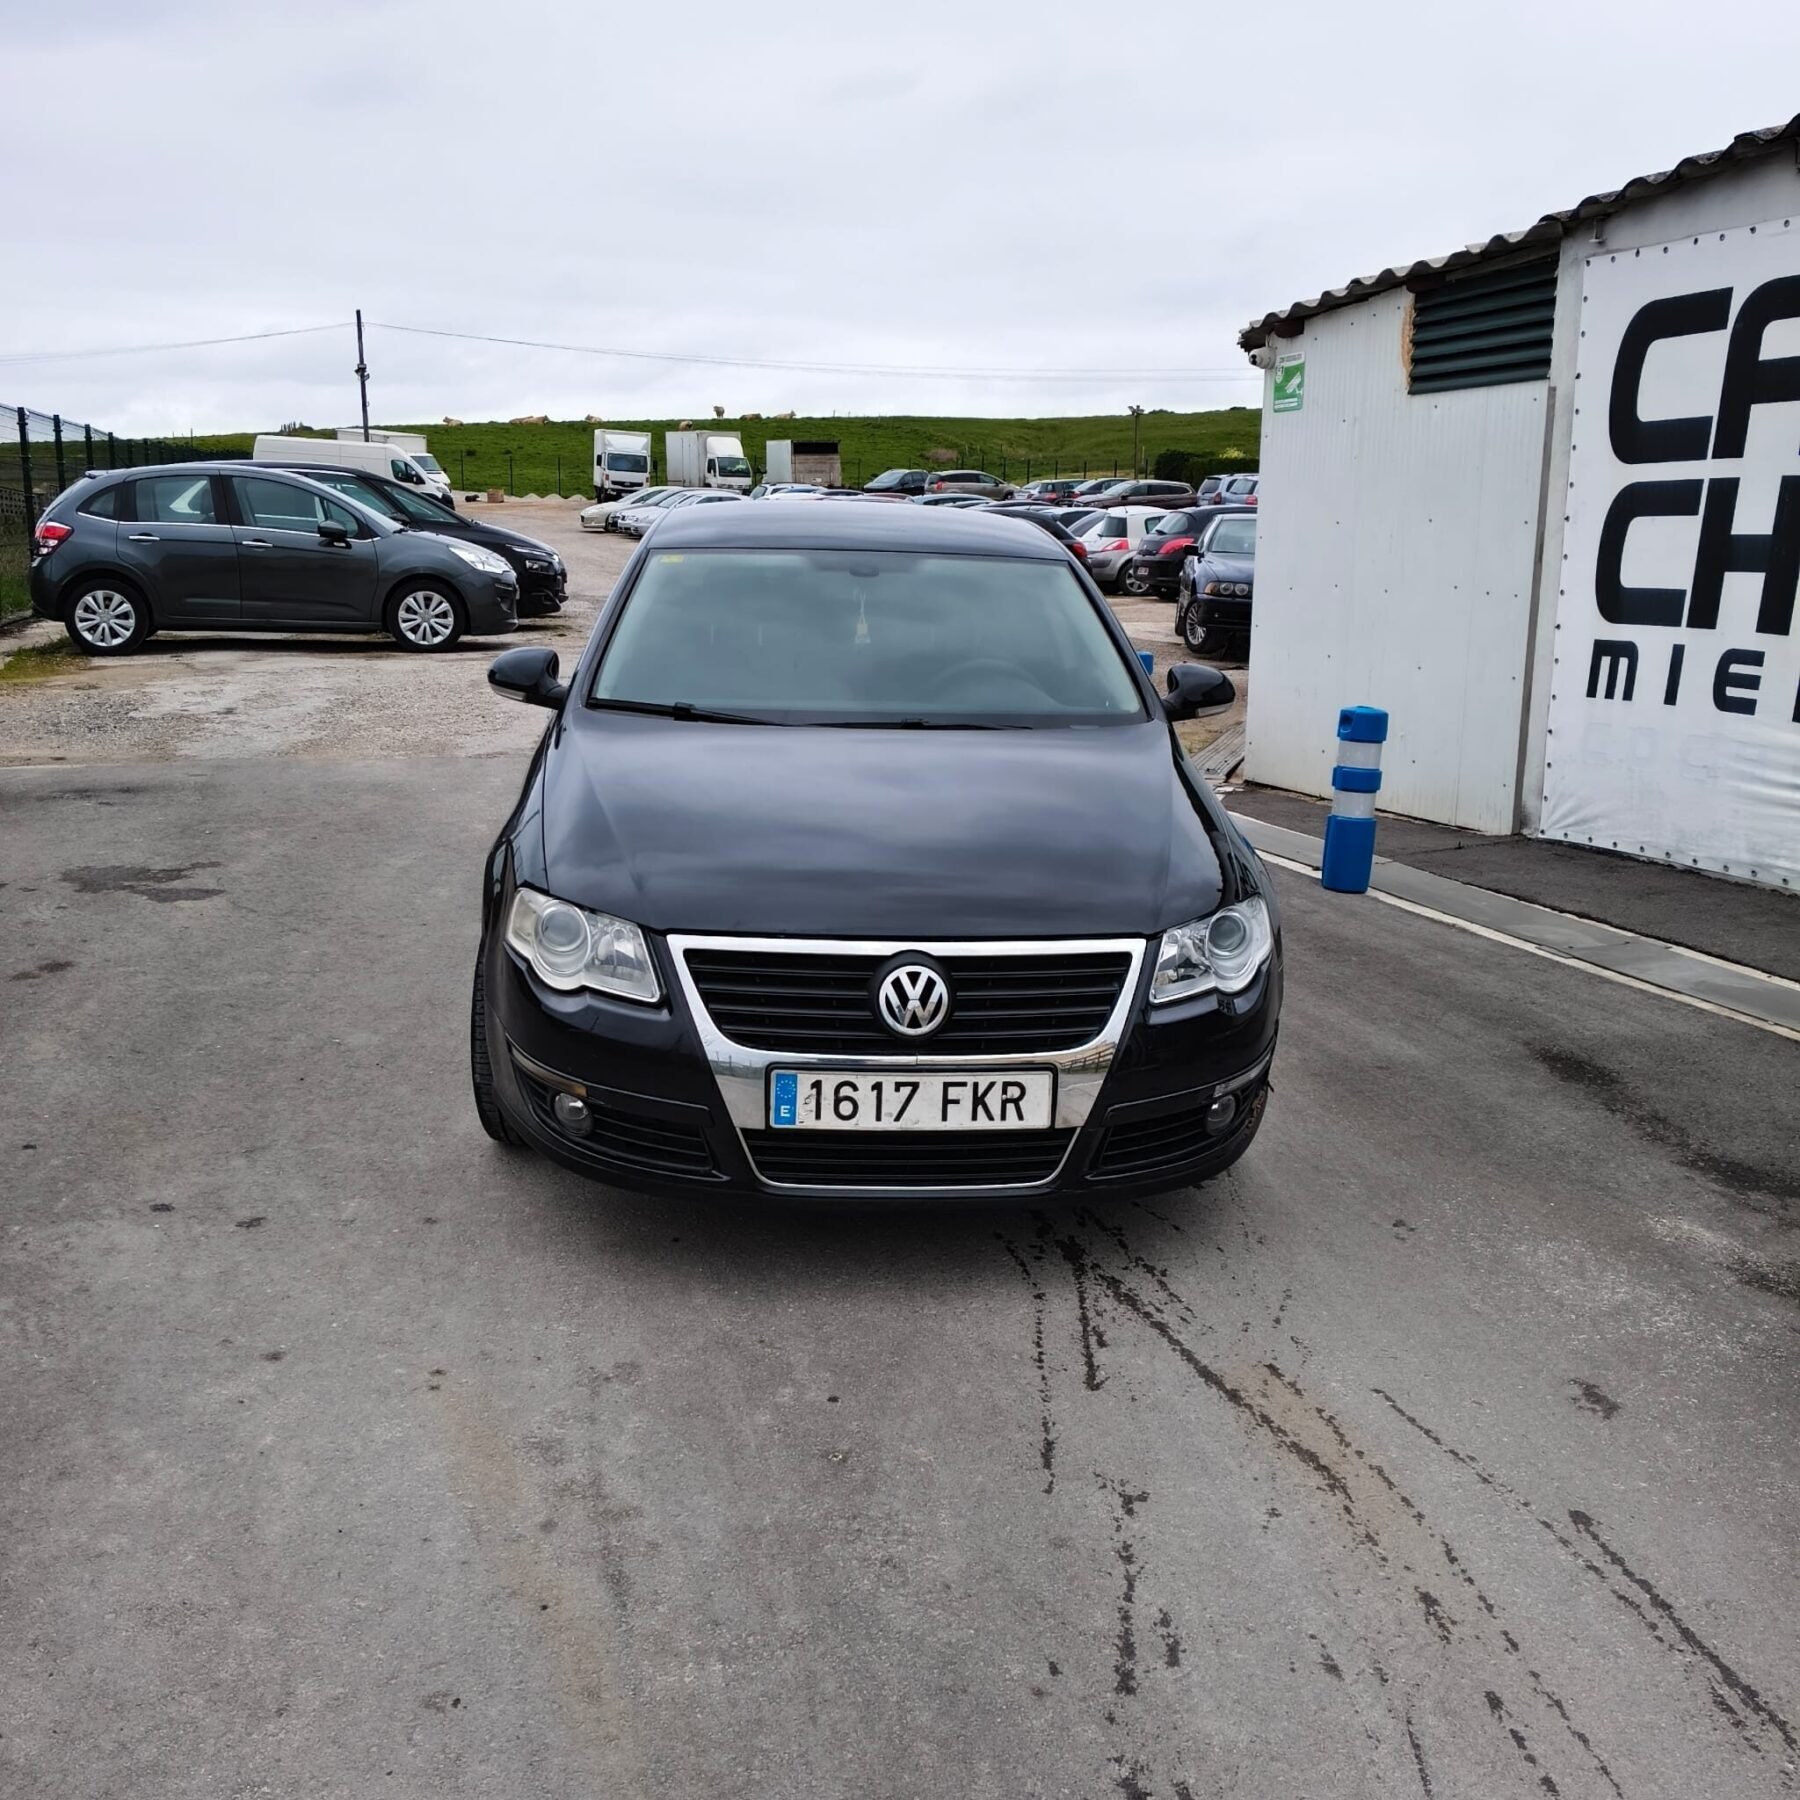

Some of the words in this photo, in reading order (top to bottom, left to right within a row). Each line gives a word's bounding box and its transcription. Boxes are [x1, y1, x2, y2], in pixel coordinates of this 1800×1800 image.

[1596, 475, 1800, 635] CH
[1586, 640, 1800, 723] MIE
[882, 967, 946, 1033] VW
[780, 1105, 791, 1117] E
[810, 1080, 920, 1122] 1617
[941, 1080, 1027, 1122] FKR
